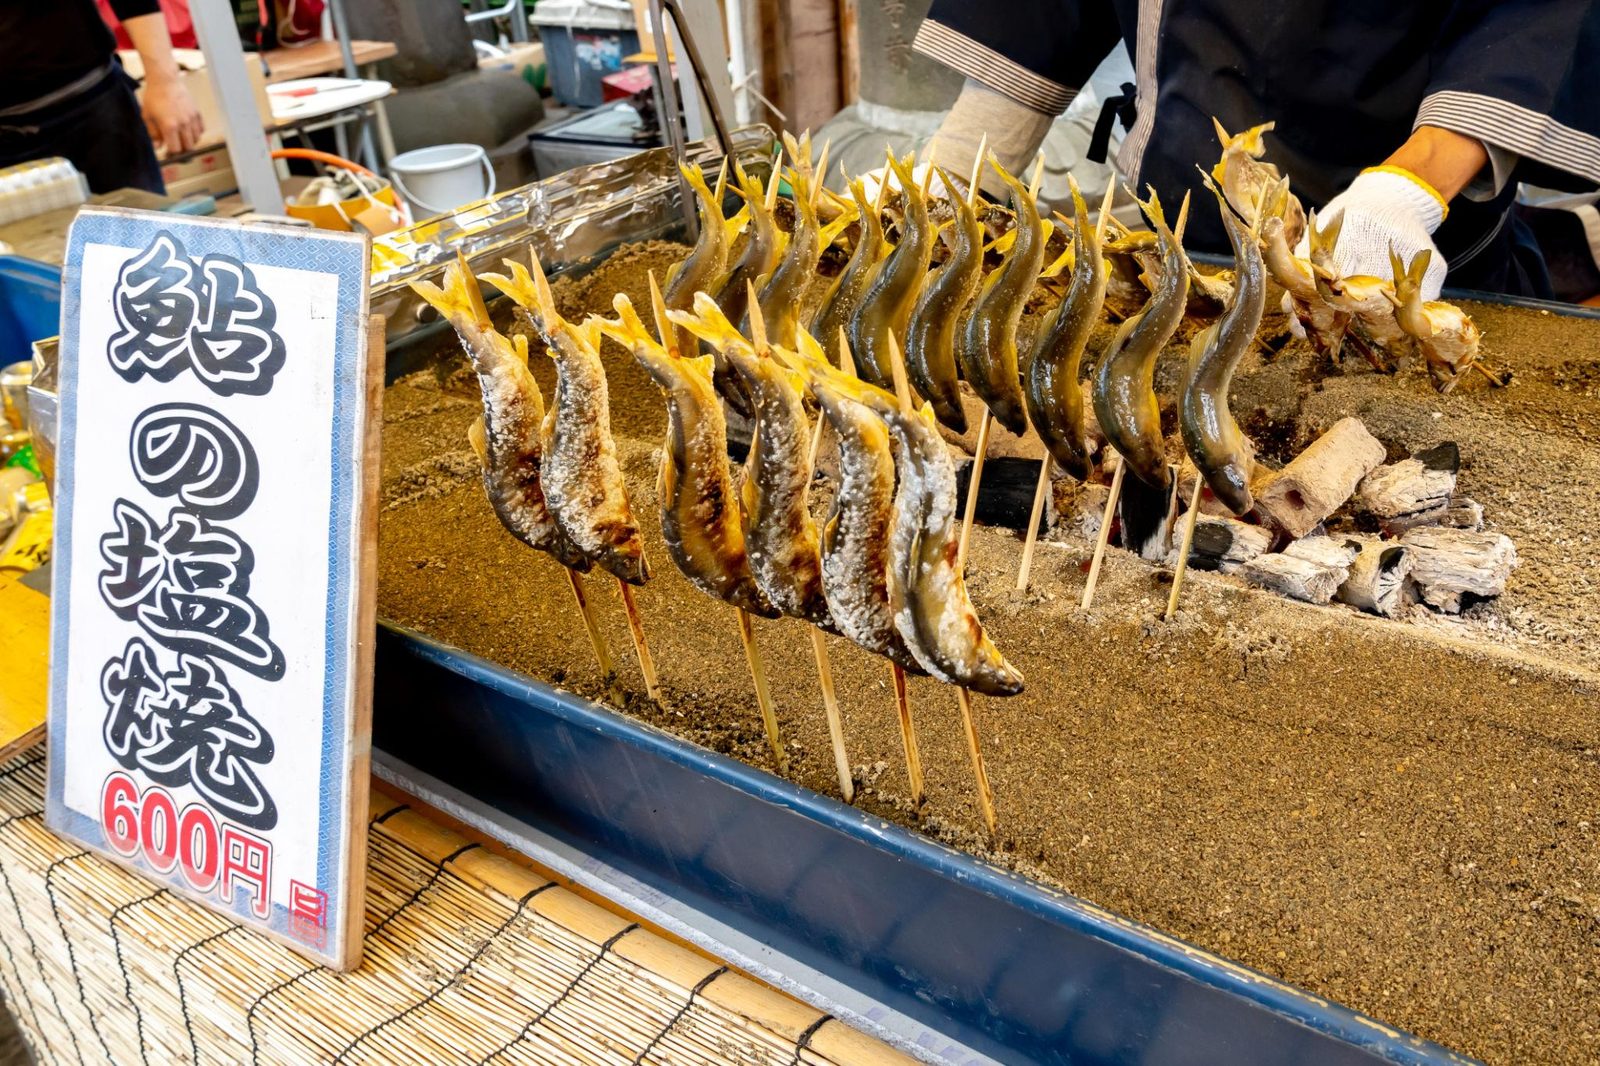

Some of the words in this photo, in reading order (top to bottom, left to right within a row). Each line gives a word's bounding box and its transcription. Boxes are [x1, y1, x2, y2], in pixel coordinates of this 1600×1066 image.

[98, 230, 286, 831] 鮎の塩焼
[101, 771, 273, 920] 600円
